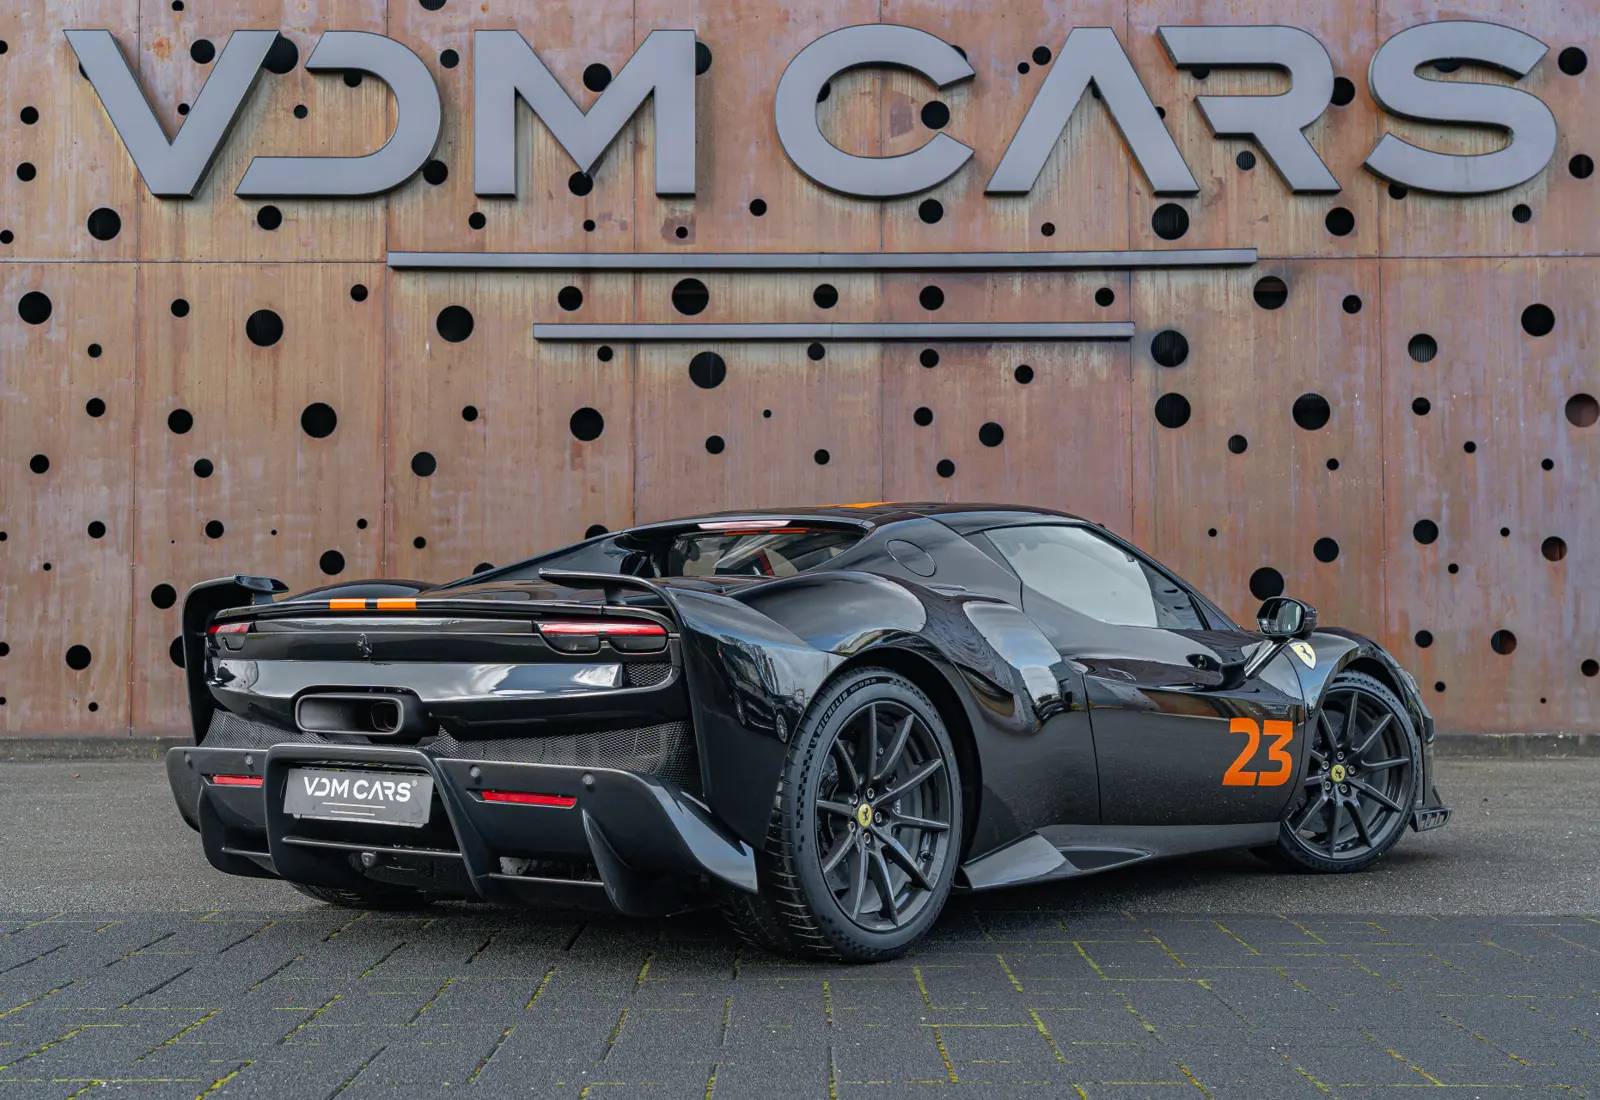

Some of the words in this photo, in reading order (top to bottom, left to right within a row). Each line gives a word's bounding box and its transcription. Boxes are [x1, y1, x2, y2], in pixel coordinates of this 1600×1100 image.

[64, 29, 697, 199] VDM
[774, 21, 1558, 197] CARS
[817, 690, 848, 735] MICHELIN
[1222, 717, 1293, 786] 23
[303, 776, 350, 798] VDM
